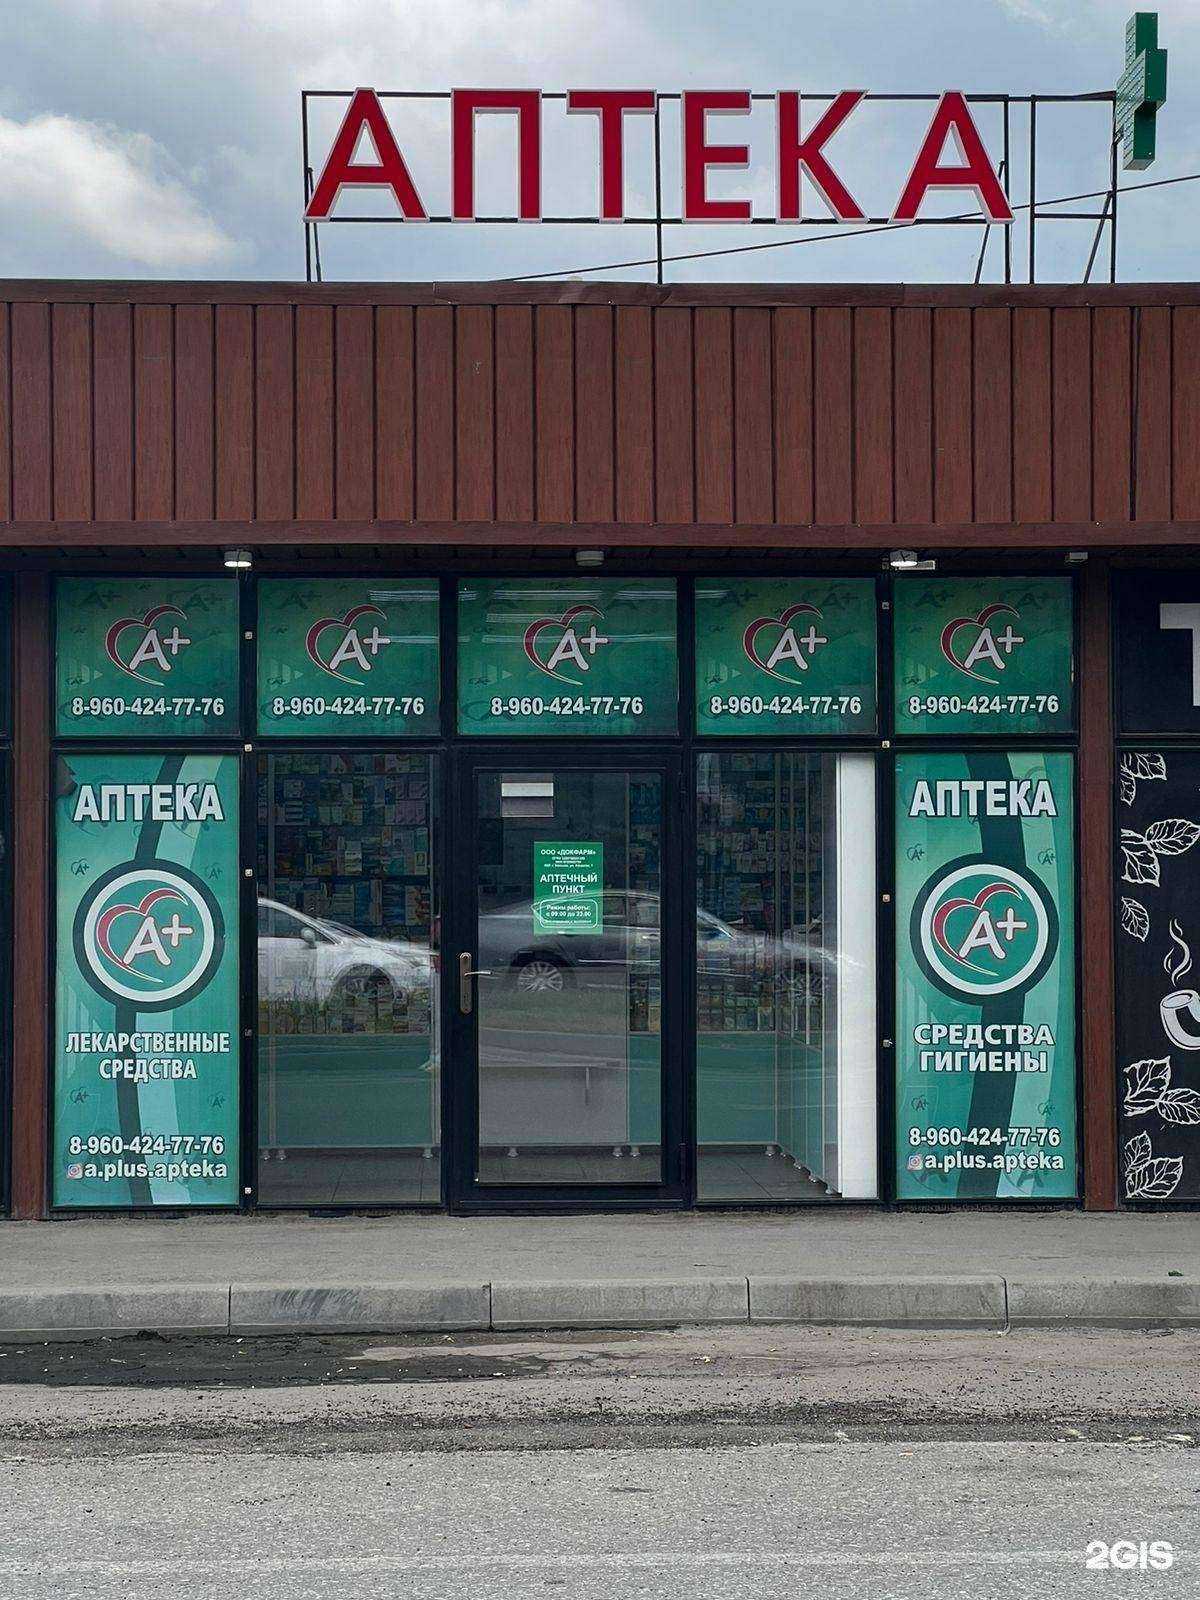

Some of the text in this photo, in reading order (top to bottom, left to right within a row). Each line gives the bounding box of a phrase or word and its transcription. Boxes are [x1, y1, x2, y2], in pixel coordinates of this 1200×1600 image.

[304, 87, 1016, 224] АПТЕКА
[72, 697, 225, 716] 8-960-424-77-76
[272, 697, 425, 715] 8-960-424-77-76
[490, 697, 644, 716] 8-960-424-77-76
[710, 696, 862, 714] 8-960-424-77-76
[908, 695, 1060, 714] 8-960-424-77-76
[73, 784, 224, 822] АПТЕКА
[909, 780, 1058, 817] АПТЕКА
[539, 872, 598, 883] АПТЕЧНЫЙ
[552, 885, 586, 894] ПУНКТ
[66, 1032, 230, 1054] ЛЕКАРСТВЕННЫЕ
[914, 1023, 1055, 1049] СРЕДСТВА
[99, 1057, 198, 1083] СРЕДСТВА
[920, 1050, 1048, 1073] ГИГИЕНЫ
[69, 1135, 225, 1155] 8-960-424-77-76
[908, 1127, 1061, 1147] 8-960-424-77-76
[83, 1159, 229, 1183] a.plus.apteka
[924, 1150, 1065, 1173] a.plus.apteka
